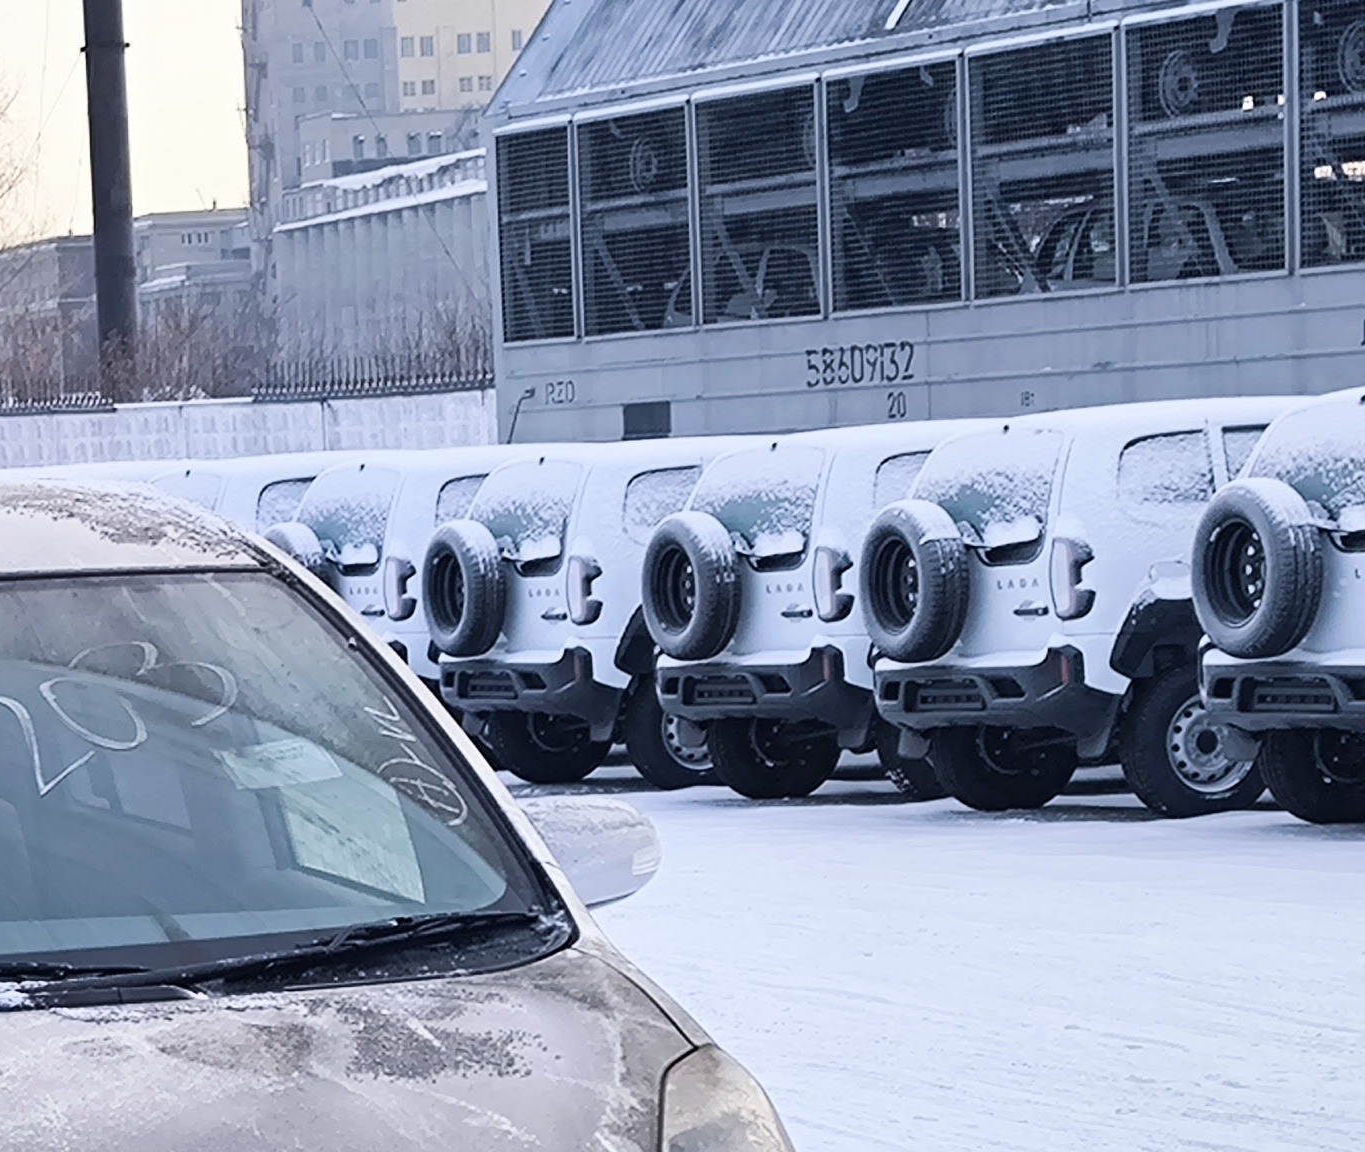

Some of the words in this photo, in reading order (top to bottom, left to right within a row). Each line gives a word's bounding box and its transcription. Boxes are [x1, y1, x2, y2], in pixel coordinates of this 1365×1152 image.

[805, 340, 915, 388] 58609132
[886, 391, 907, 419] 20
[765, 583, 804, 594] LADA
[997, 578, 1039, 590] LADA
